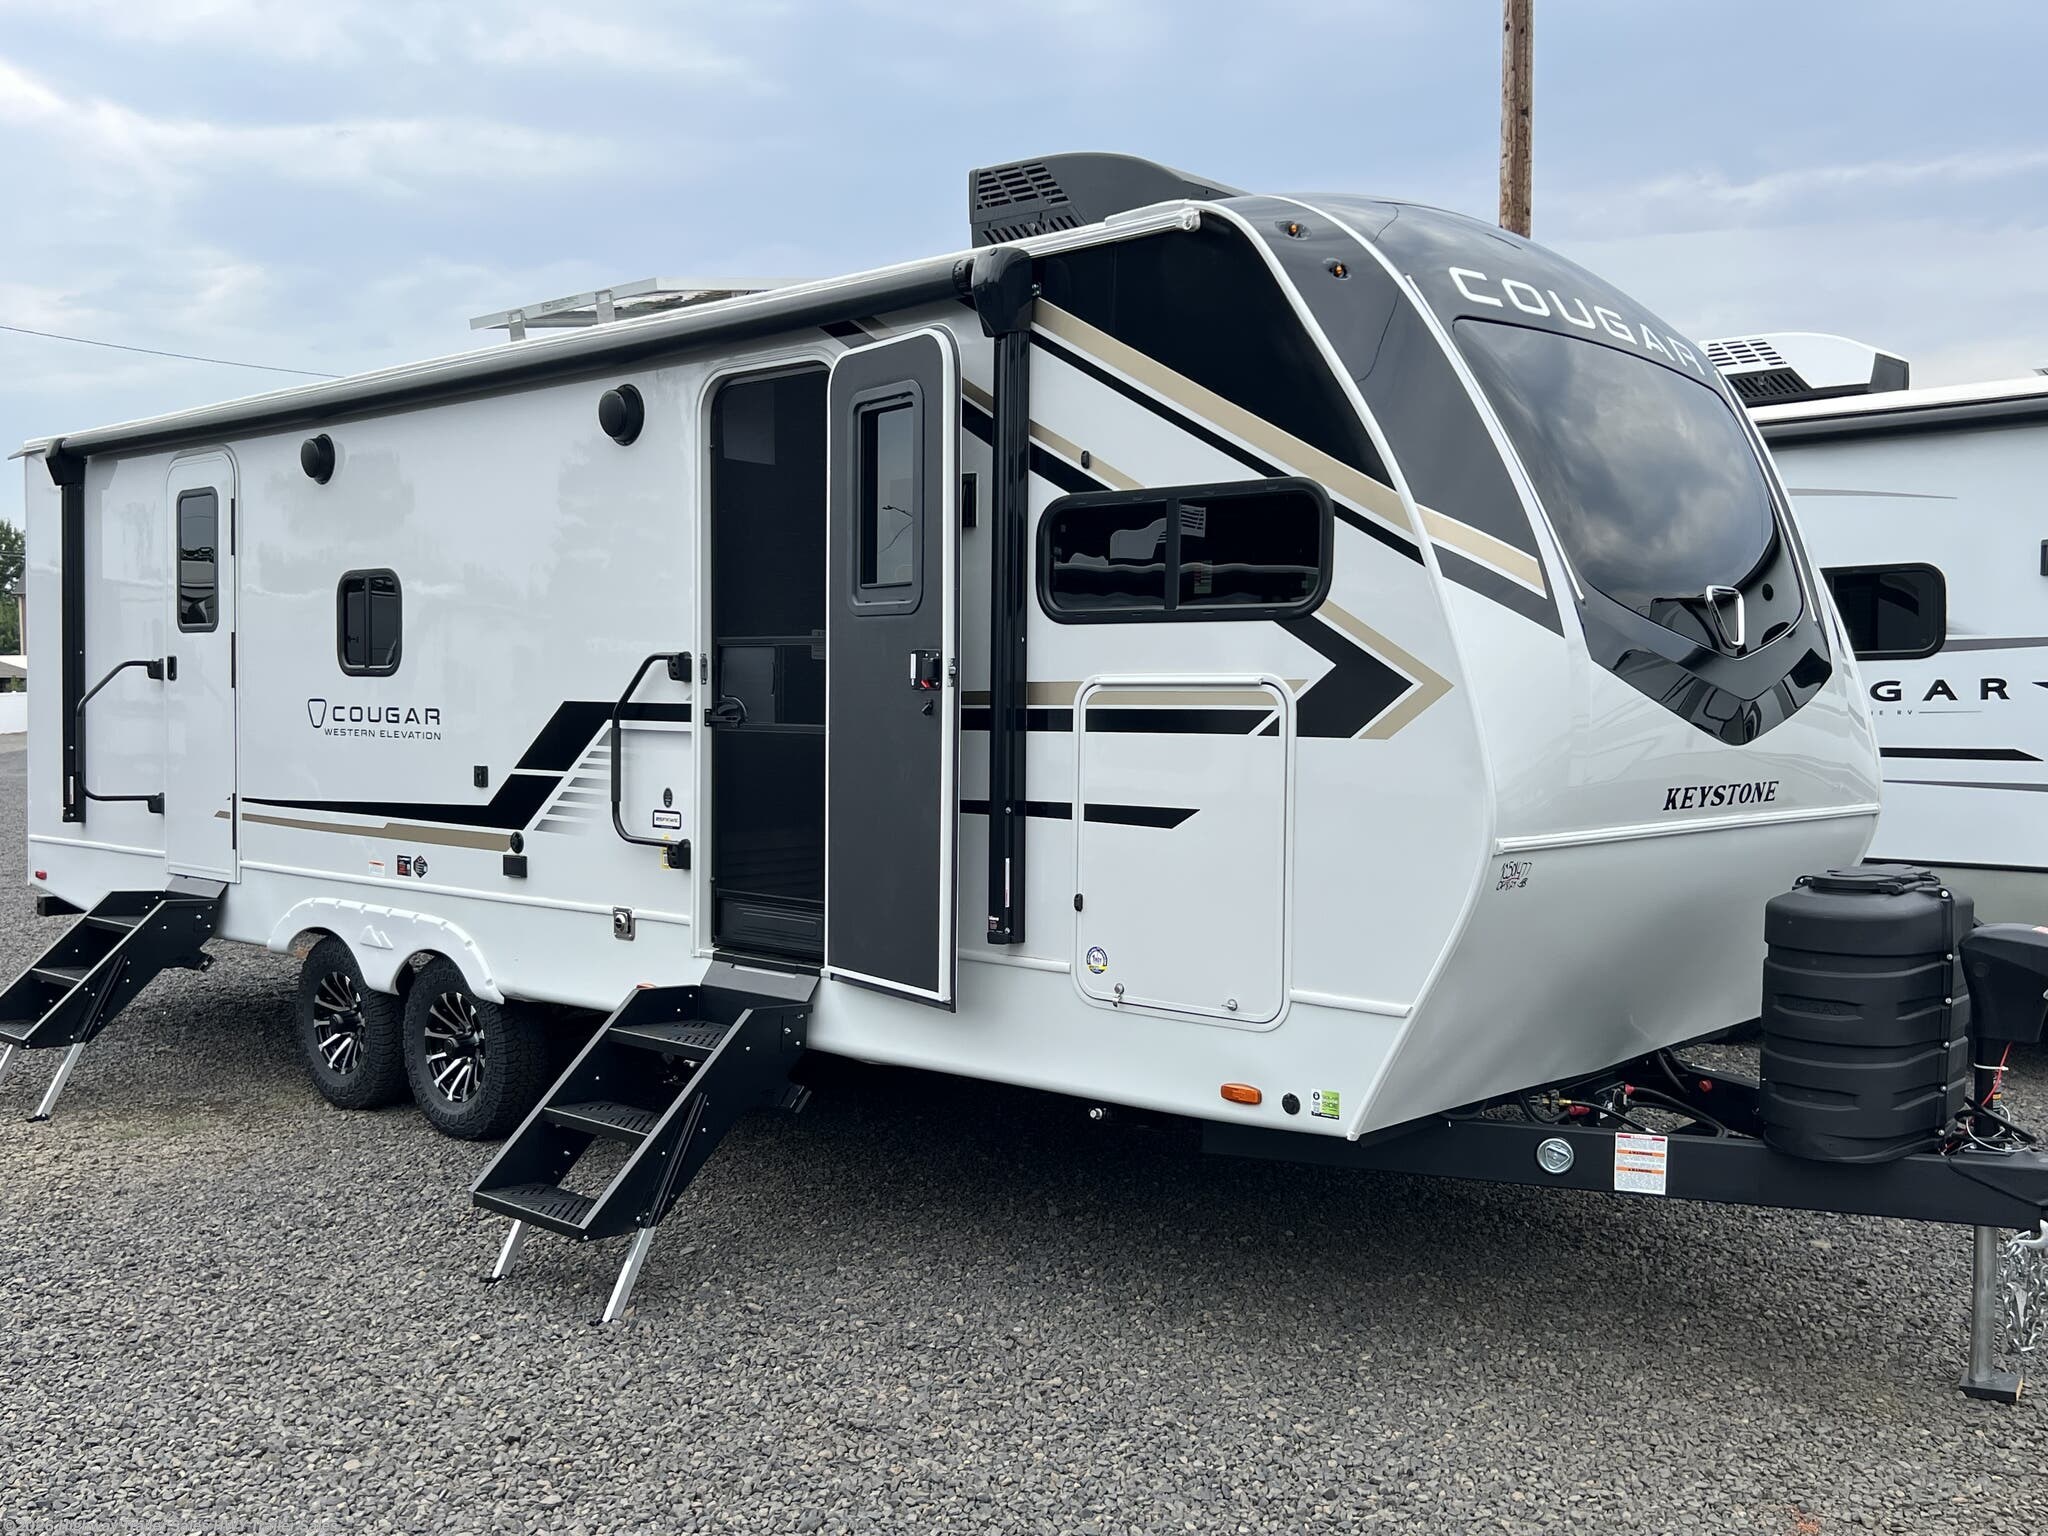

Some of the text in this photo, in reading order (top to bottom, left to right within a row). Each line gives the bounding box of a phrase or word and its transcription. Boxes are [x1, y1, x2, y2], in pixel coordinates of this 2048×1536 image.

[1448, 266, 1706, 376] COUGAR
[332, 706, 441, 725] COUGAR
[324, 728, 441, 741] WESTERN ELEVATION
[1662, 780, 1780, 811] KEYSTONE
